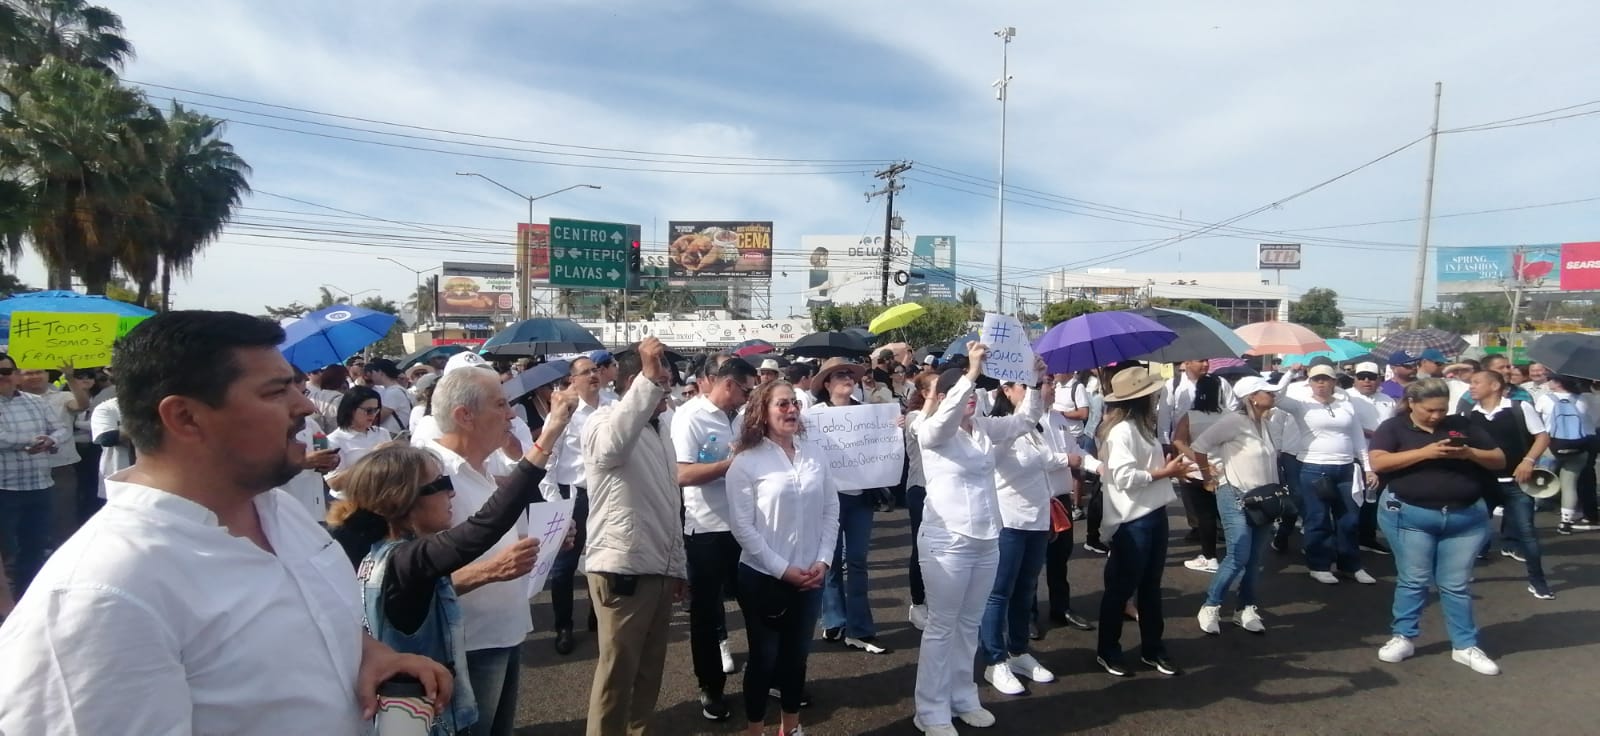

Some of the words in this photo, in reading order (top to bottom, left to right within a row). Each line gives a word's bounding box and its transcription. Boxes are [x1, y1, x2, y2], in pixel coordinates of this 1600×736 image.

[554, 226, 607, 242] CENTRO
[736, 232, 770, 249] CENA
[583, 249, 625, 263] TEPIC
[1452, 255, 1487, 264] SPRING
[555, 264, 603, 280] PLAYAS
[1457, 262, 1499, 272] FASHION
[1565, 260, 1600, 270] SEARS
